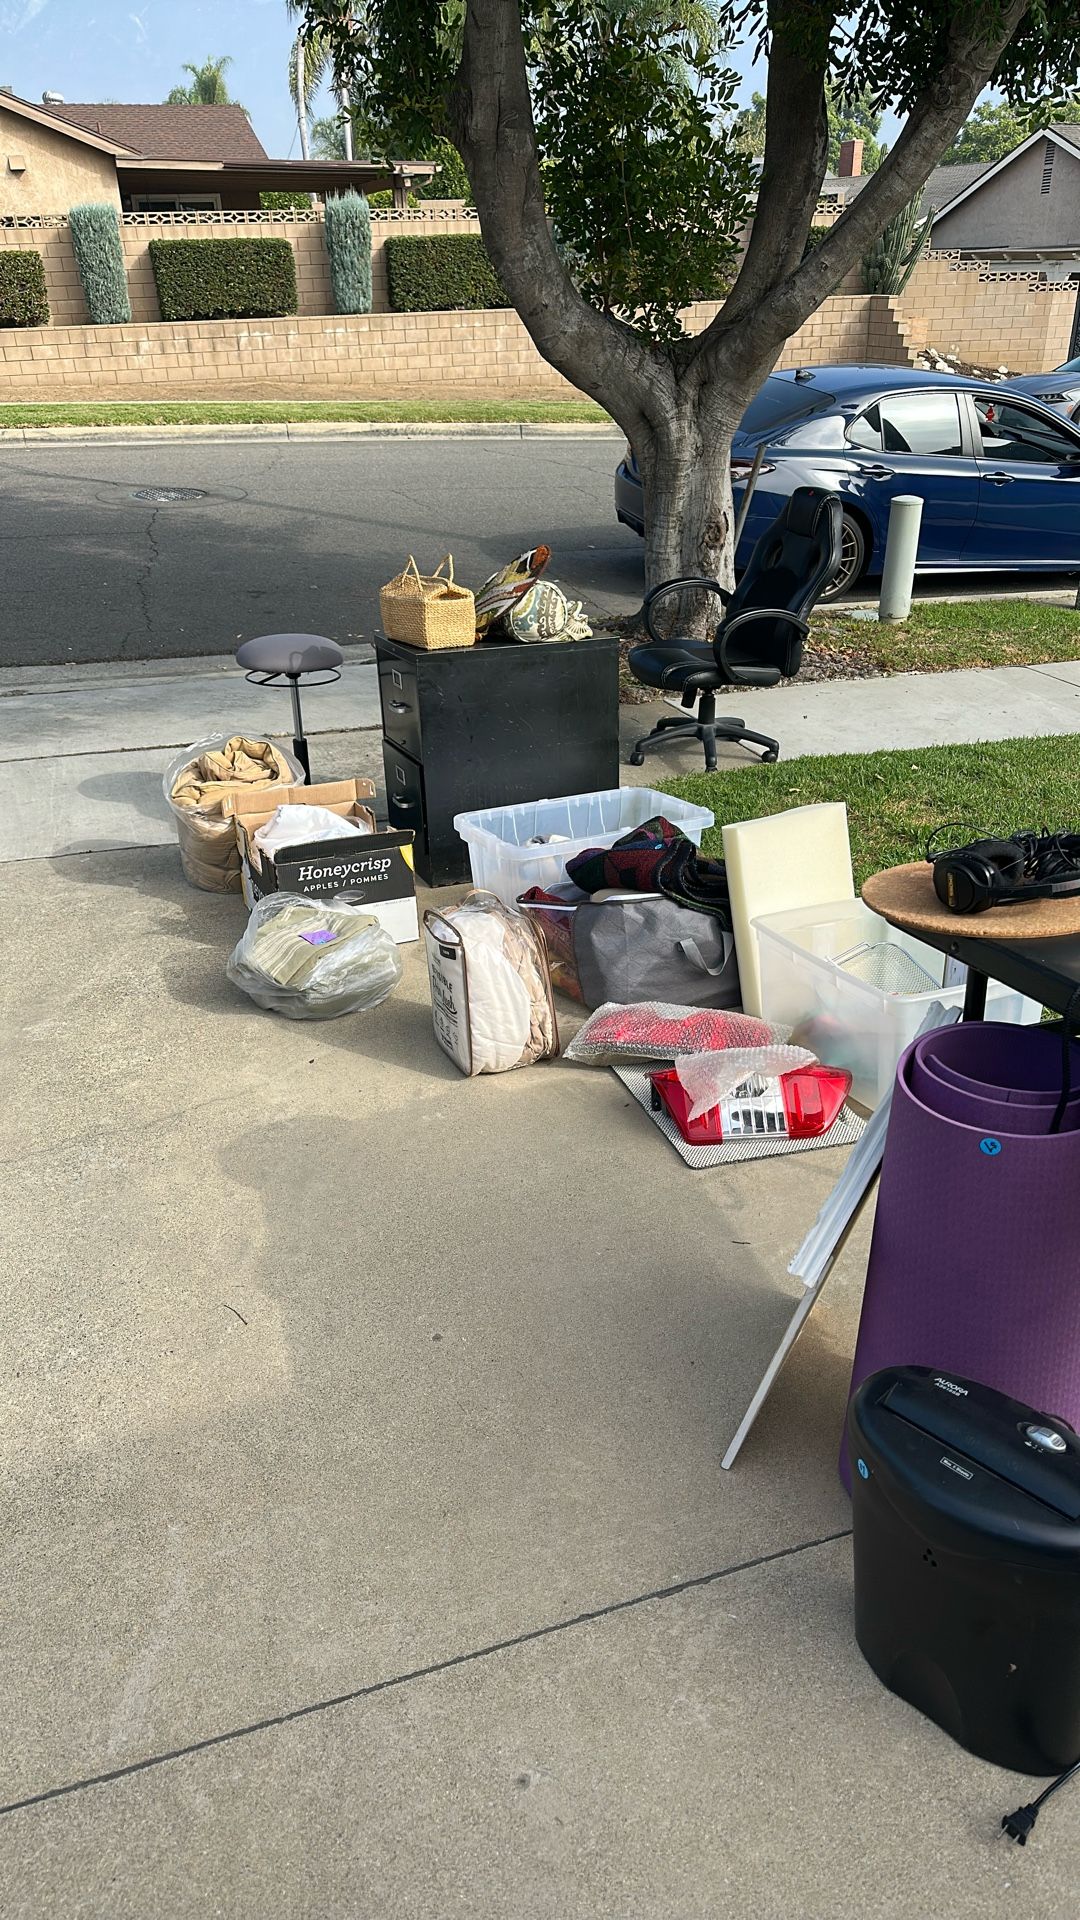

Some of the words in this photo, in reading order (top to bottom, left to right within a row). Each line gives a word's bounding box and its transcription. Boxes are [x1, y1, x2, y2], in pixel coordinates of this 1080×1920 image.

[298, 857, 391, 881] Honeycrisp
[303, 882, 339, 892] APPLES
[350, 873, 389, 884] POMMES
[934, 1377, 968, 1396] AURORA
